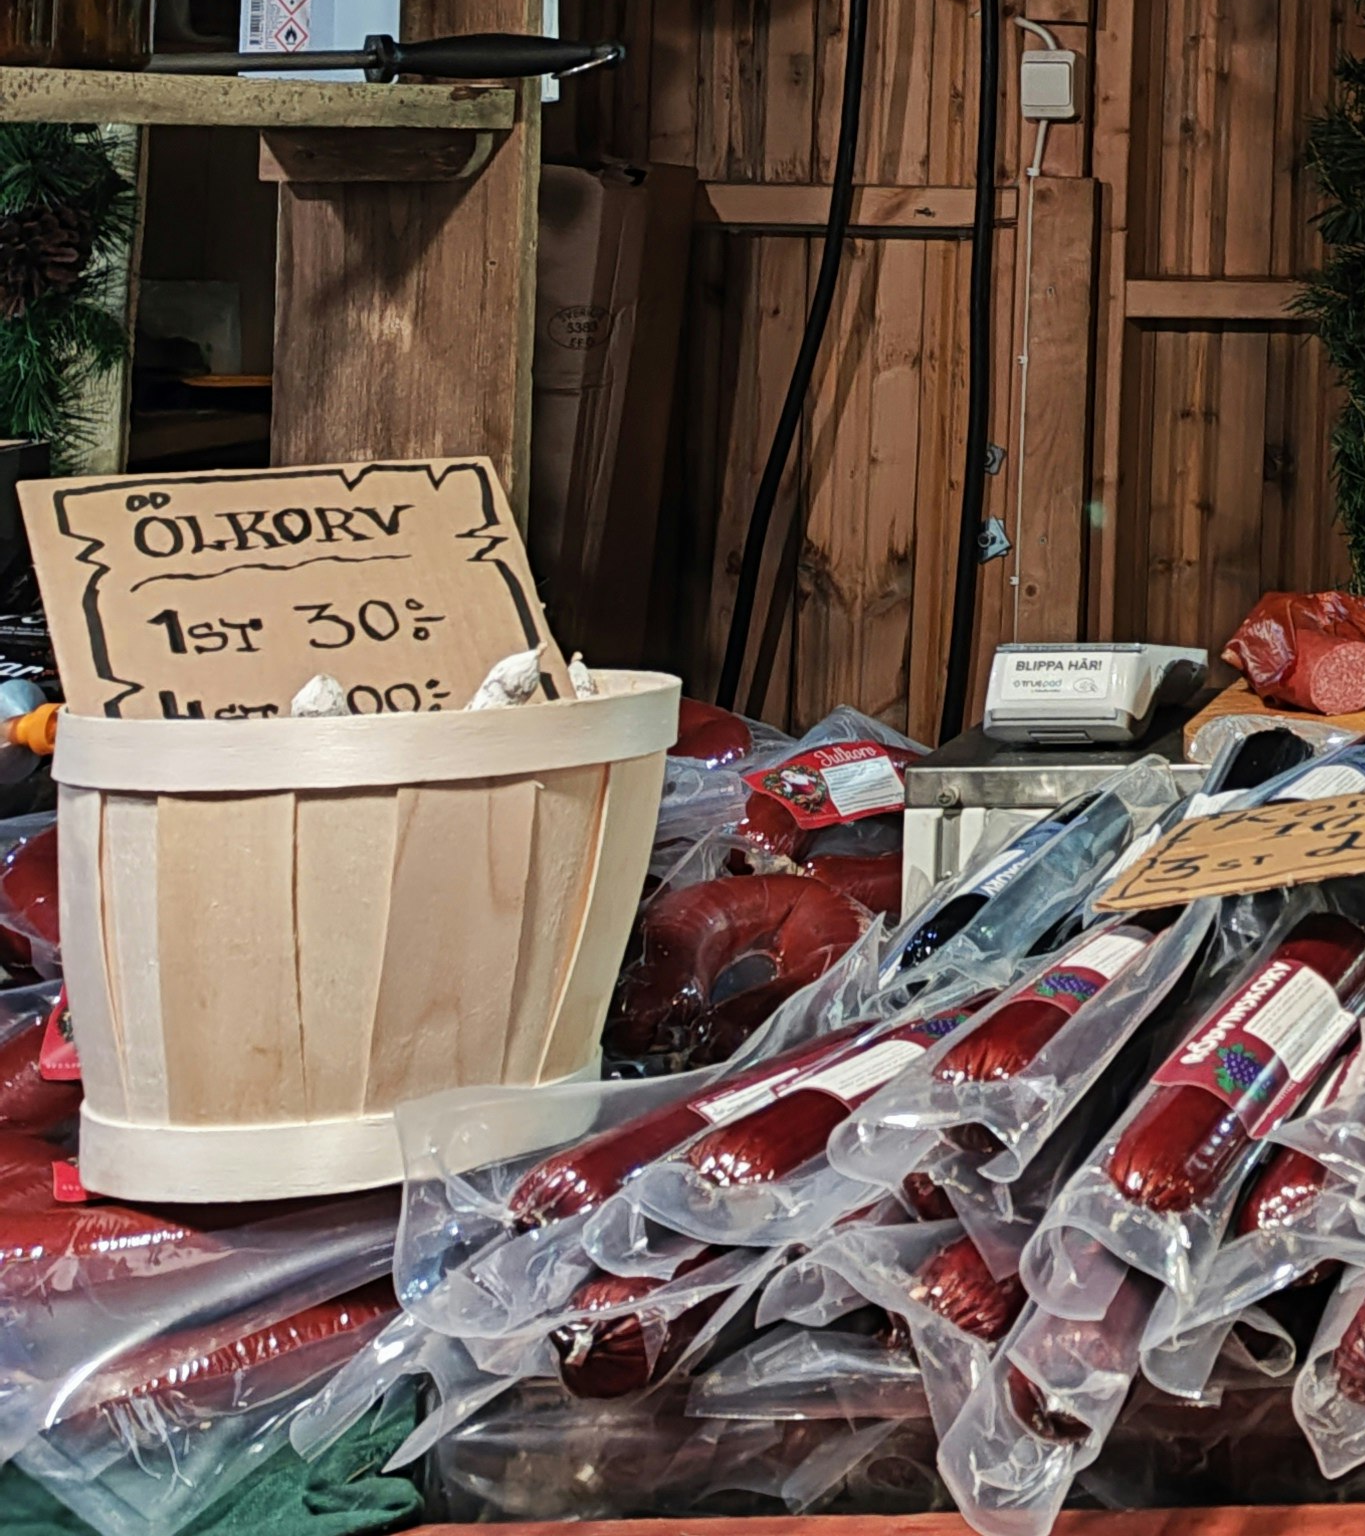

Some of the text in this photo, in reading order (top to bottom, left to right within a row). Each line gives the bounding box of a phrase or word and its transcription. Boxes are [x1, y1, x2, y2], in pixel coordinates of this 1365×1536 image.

[126, 491, 416, 558] ÖLKORV
[1015, 657, 1103, 672] BLIPPA HÄR!
[814, 745, 877, 767] Julkorv
